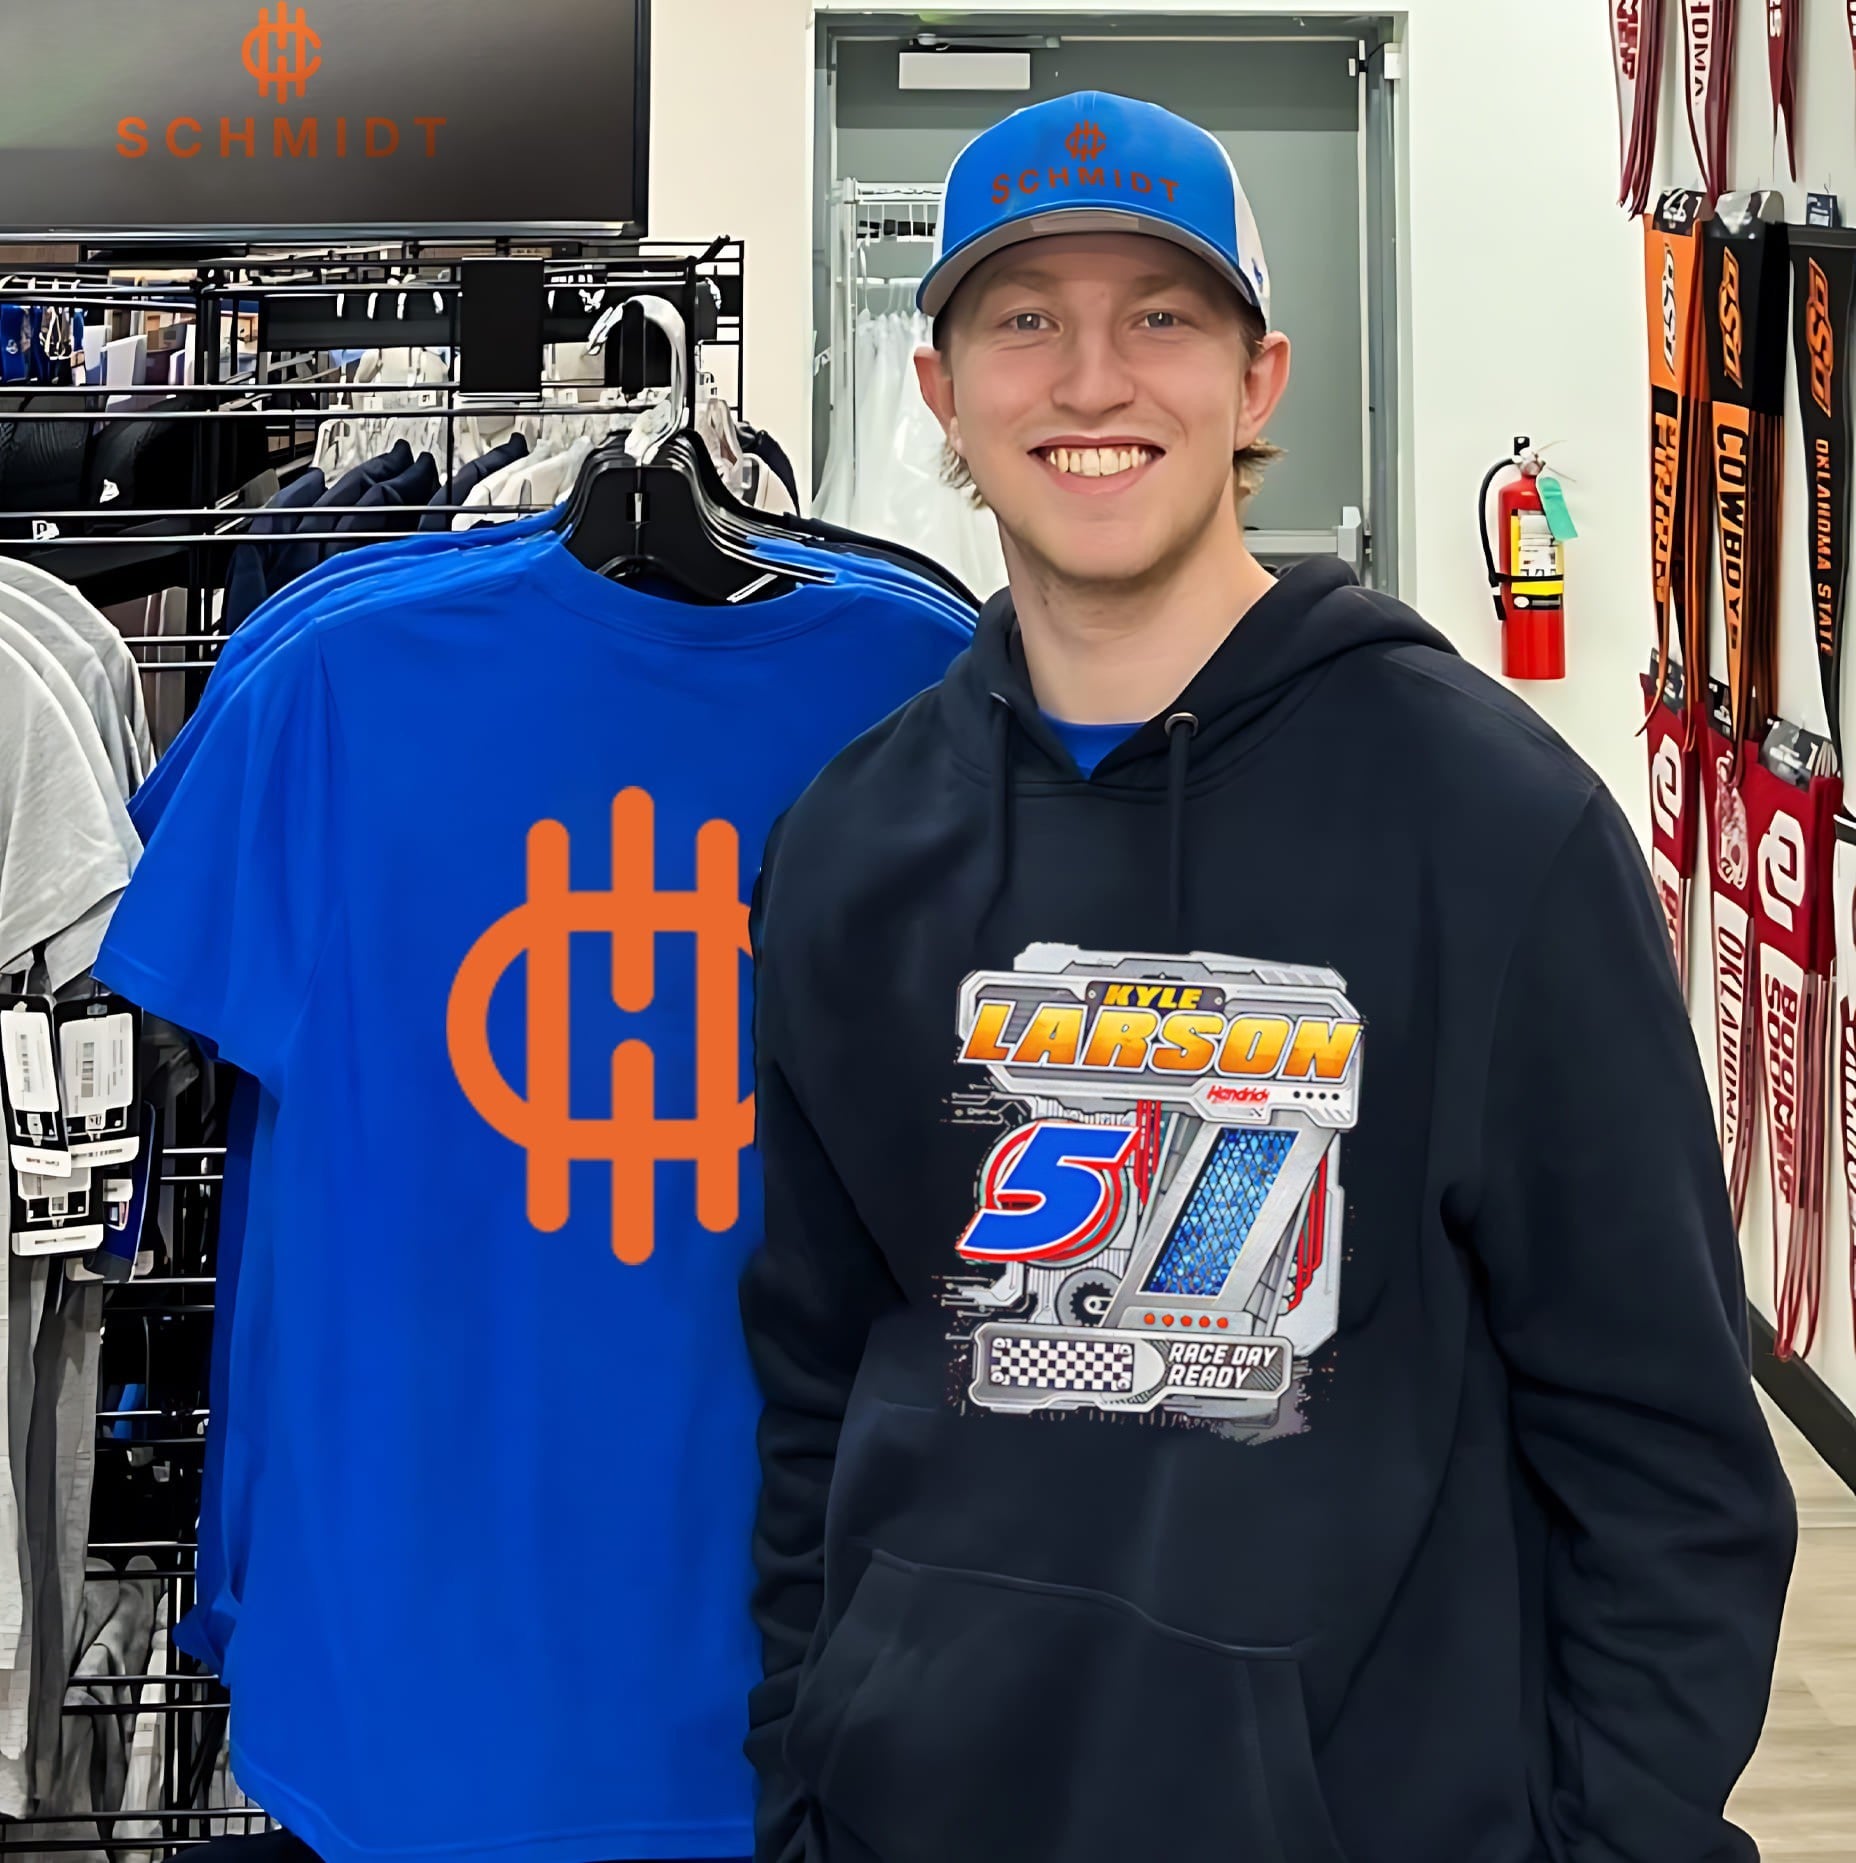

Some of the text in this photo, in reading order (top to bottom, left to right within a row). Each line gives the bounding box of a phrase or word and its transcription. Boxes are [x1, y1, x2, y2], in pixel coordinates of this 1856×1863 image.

[115, 116, 447, 158] SCHMIDT
[991, 167, 1179, 205] SCHMIDT
[1101, 984, 1203, 1010] KYLE
[957, 999, 1363, 1083] LARSON
[956, 1122, 1139, 1259] 5
[1168, 1341, 1279, 1368] RACE DAY
[1168, 1364, 1250, 1389] READY
